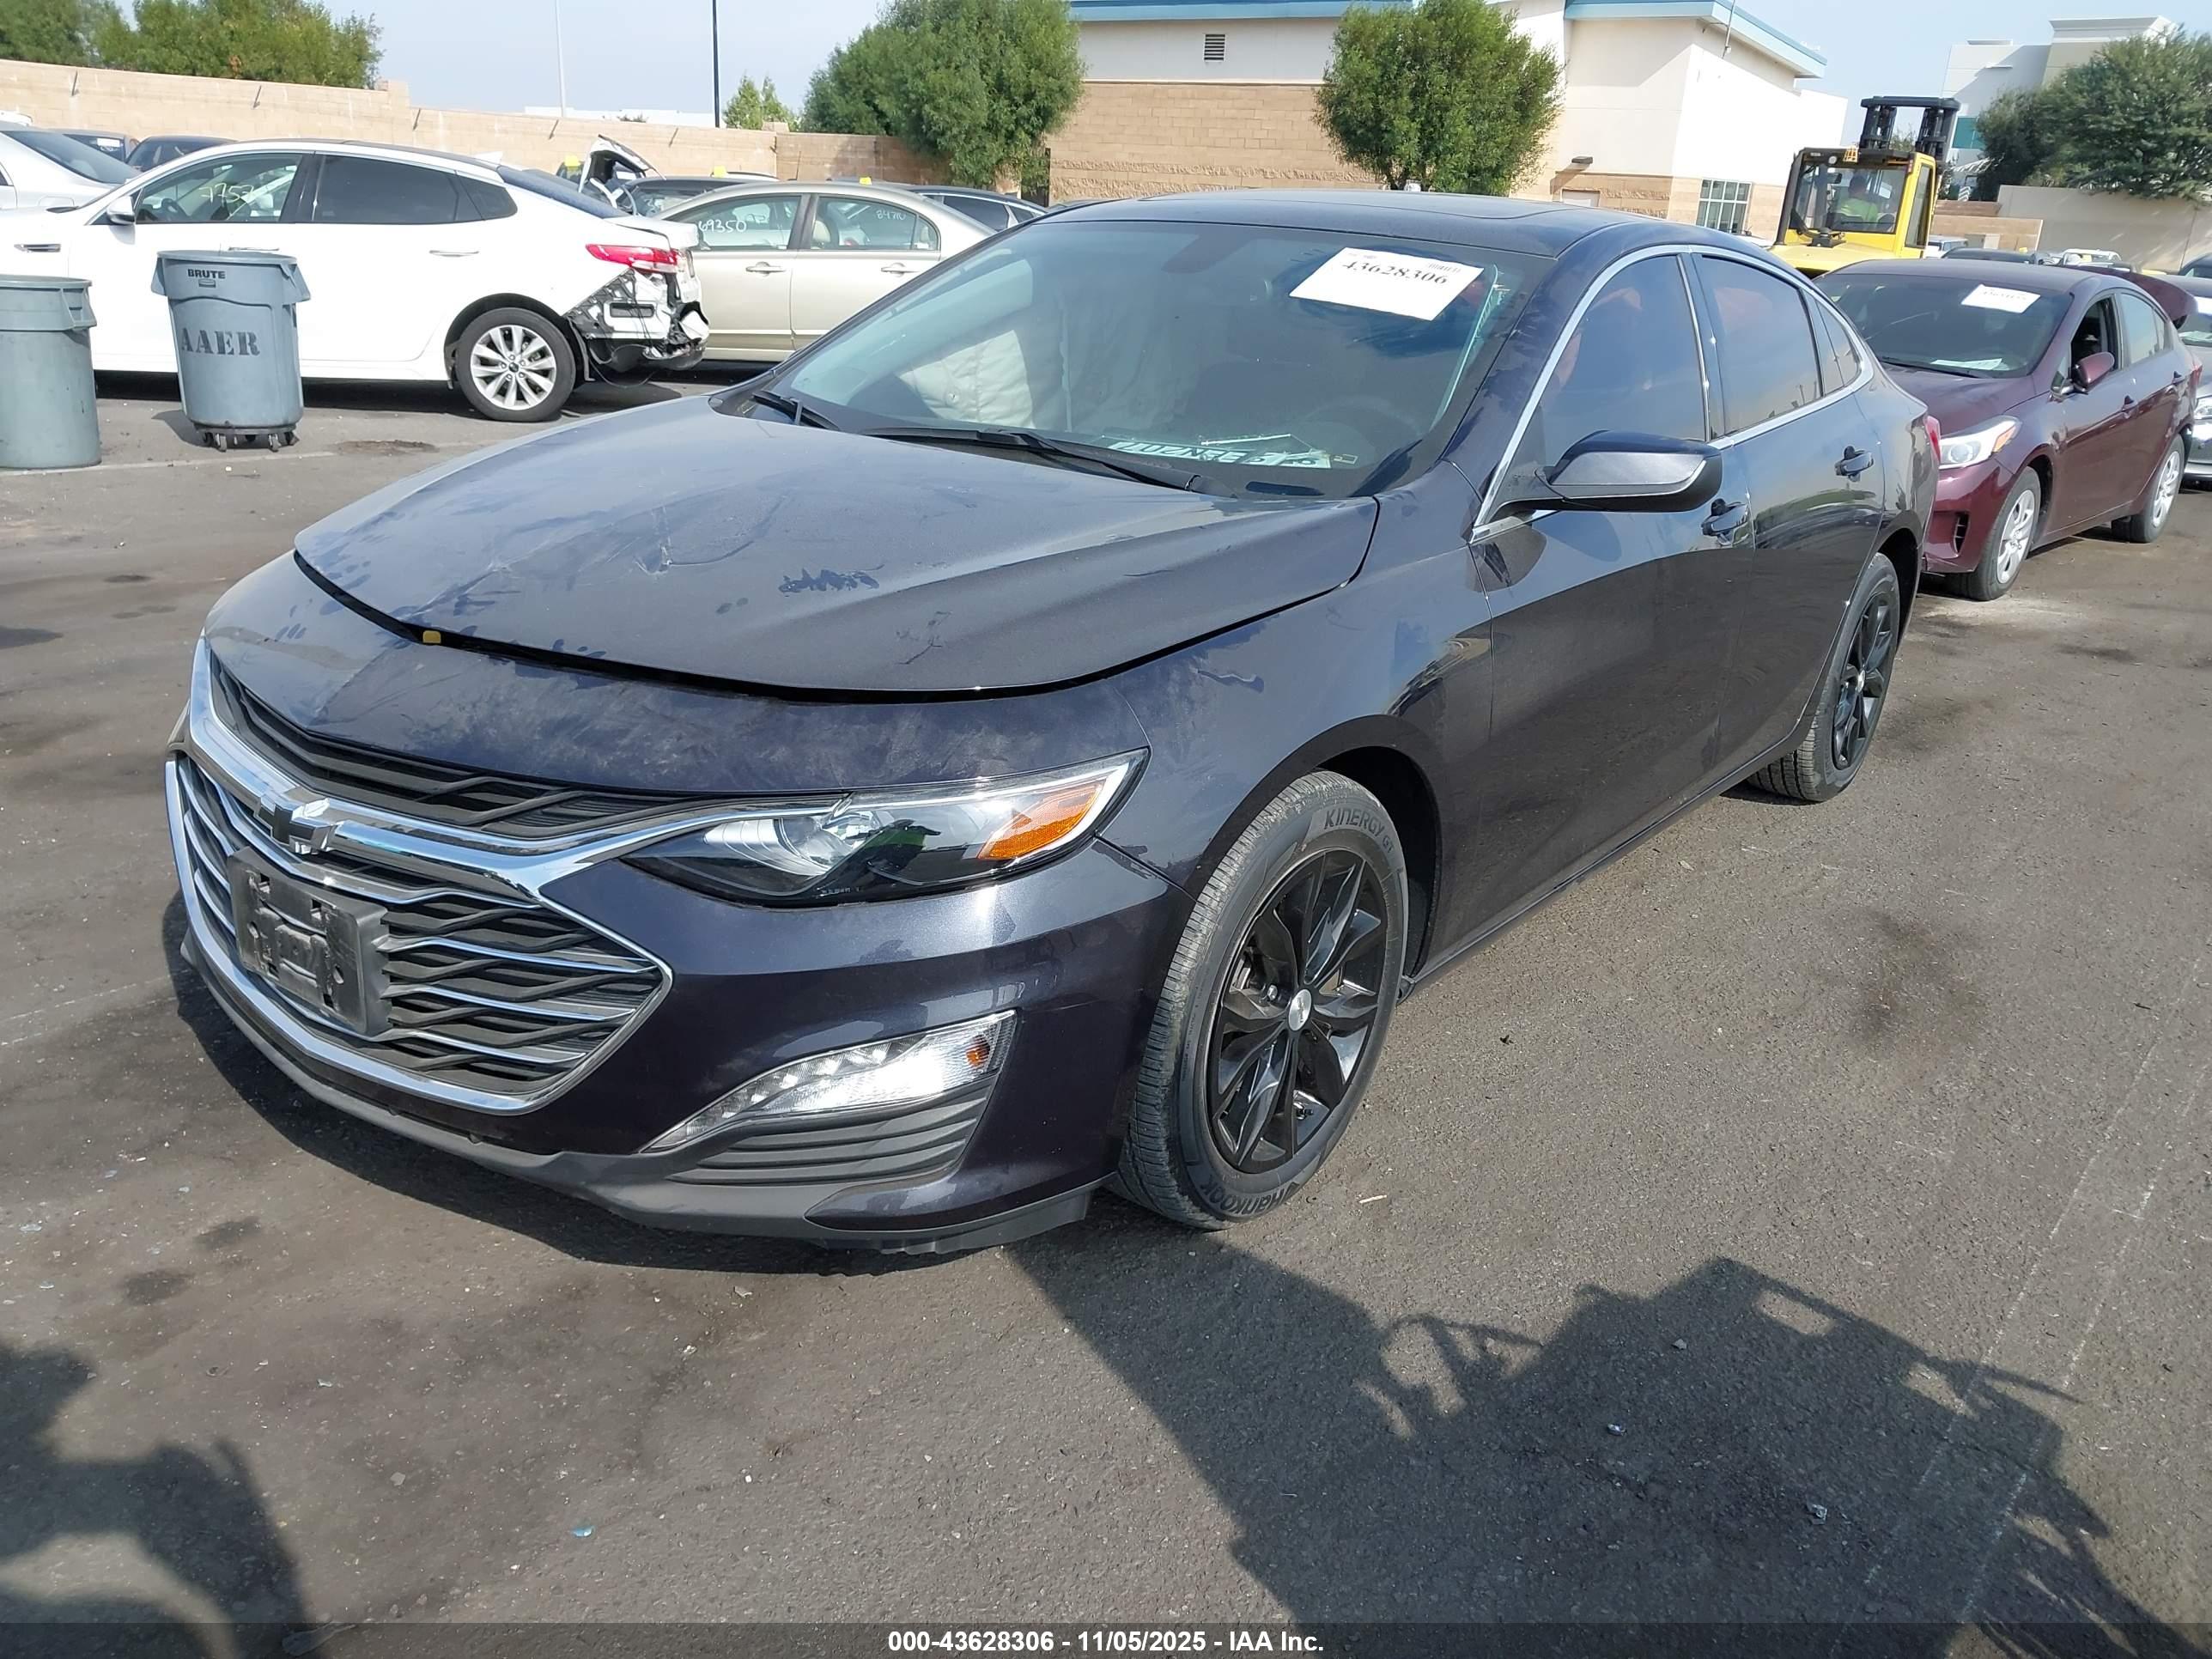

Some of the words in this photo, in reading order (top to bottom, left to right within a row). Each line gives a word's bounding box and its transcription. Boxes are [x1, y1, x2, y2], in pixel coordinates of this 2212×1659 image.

[698, 219, 747, 234] 69350
[187, 269, 226, 279] BRUTE
[1342, 260, 1449, 285] 43628306
[181, 327, 260, 356] AAER
[1323, 807, 1385, 837] KINERGY
